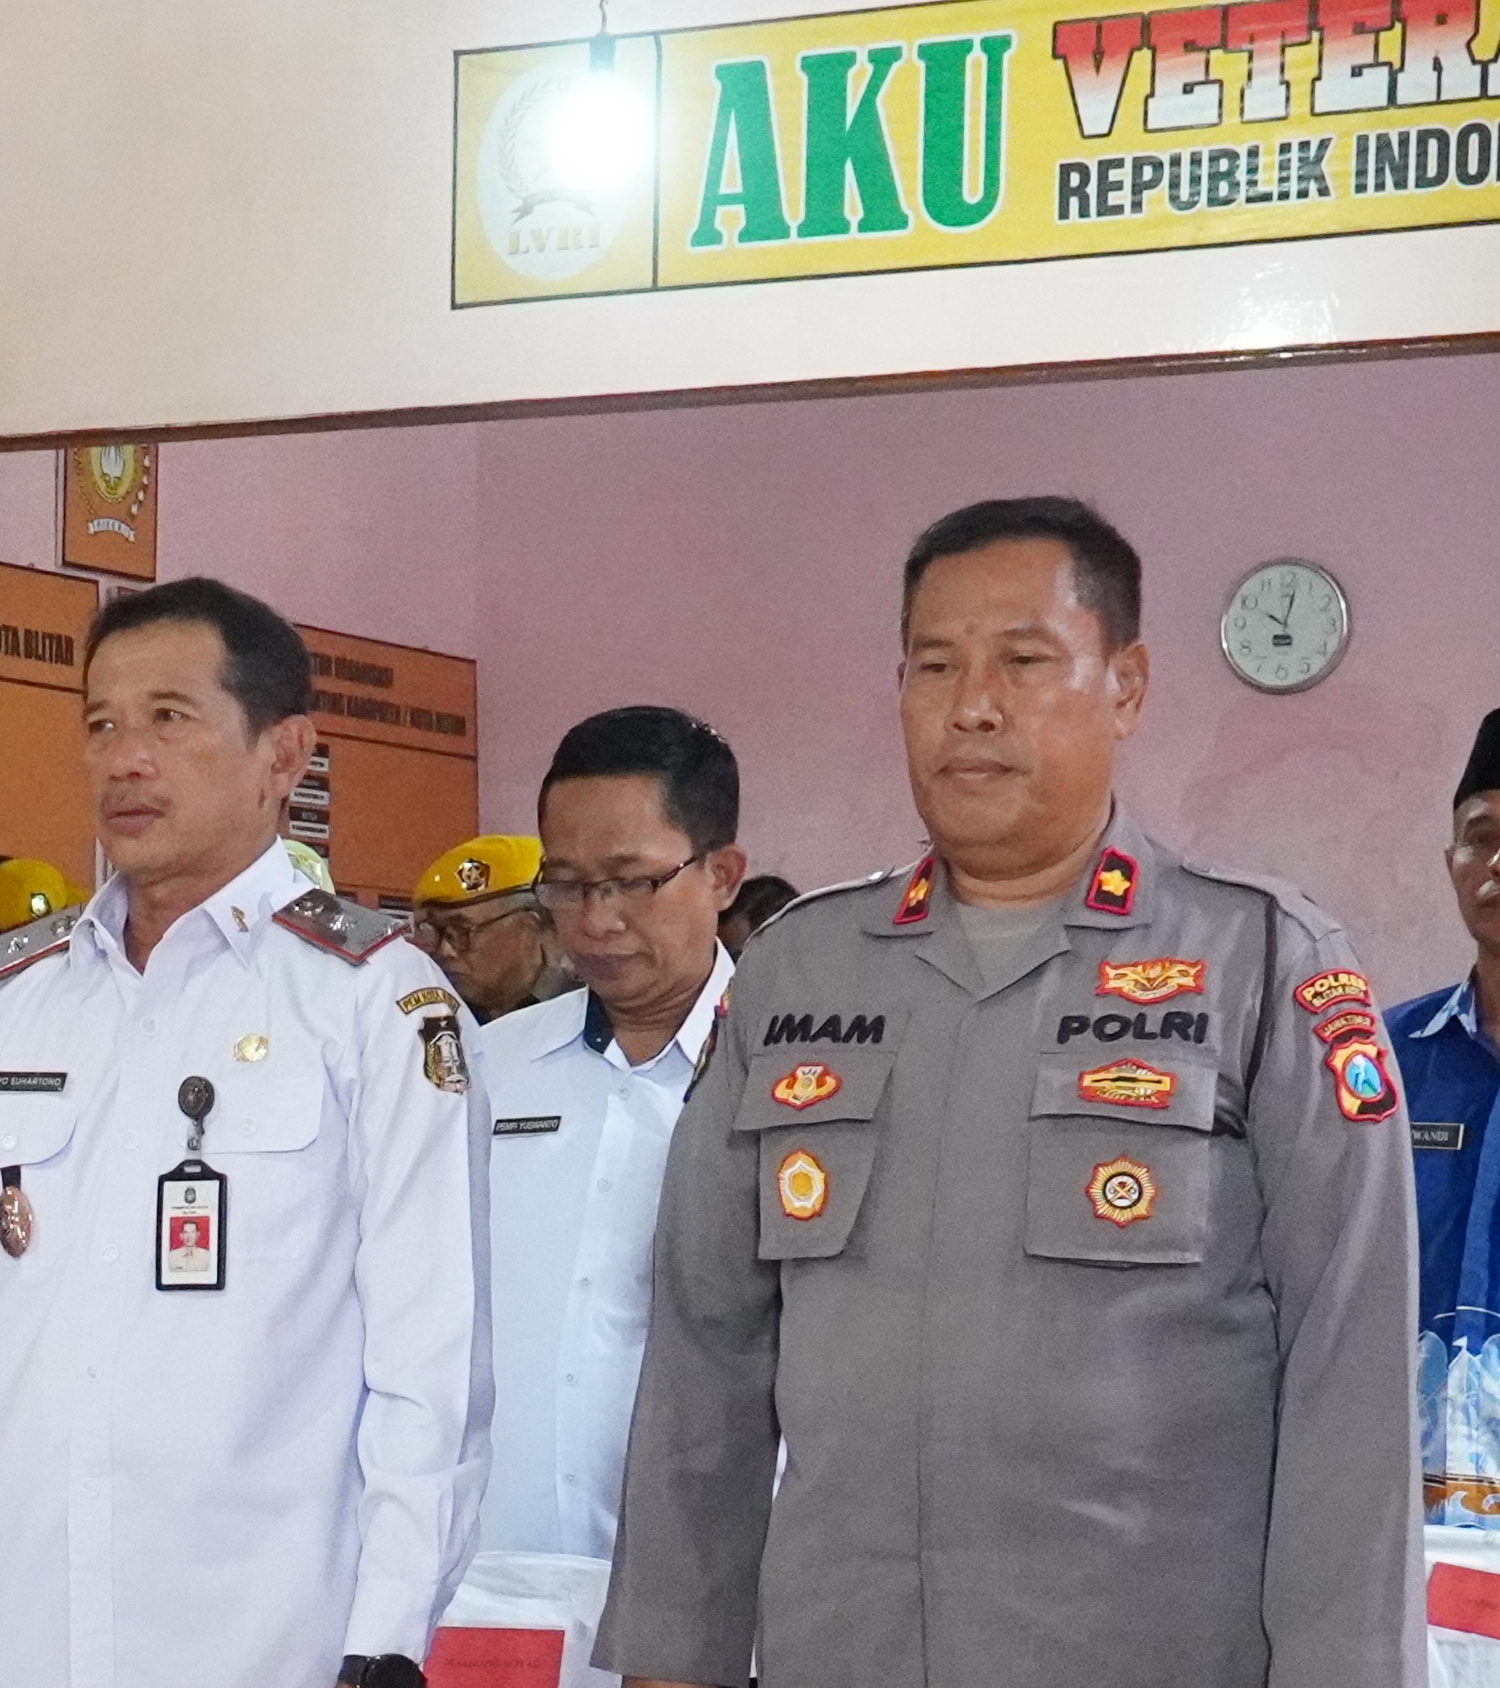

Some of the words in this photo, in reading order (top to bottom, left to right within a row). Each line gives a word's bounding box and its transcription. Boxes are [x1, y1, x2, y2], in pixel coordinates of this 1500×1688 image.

[692, 34, 1016, 248] AKU
[1058, 136, 1334, 220] REPUBLIK
[1320, 594, 1331, 612] 2
[1326, 617, 1337, 635] 3
[24, 628, 74, 666] BLITAR
[1275, 663, 1288, 680] 6
[763, 1014, 885, 1046] IMAM
[1056, 1011, 1209, 1044] POLRI
